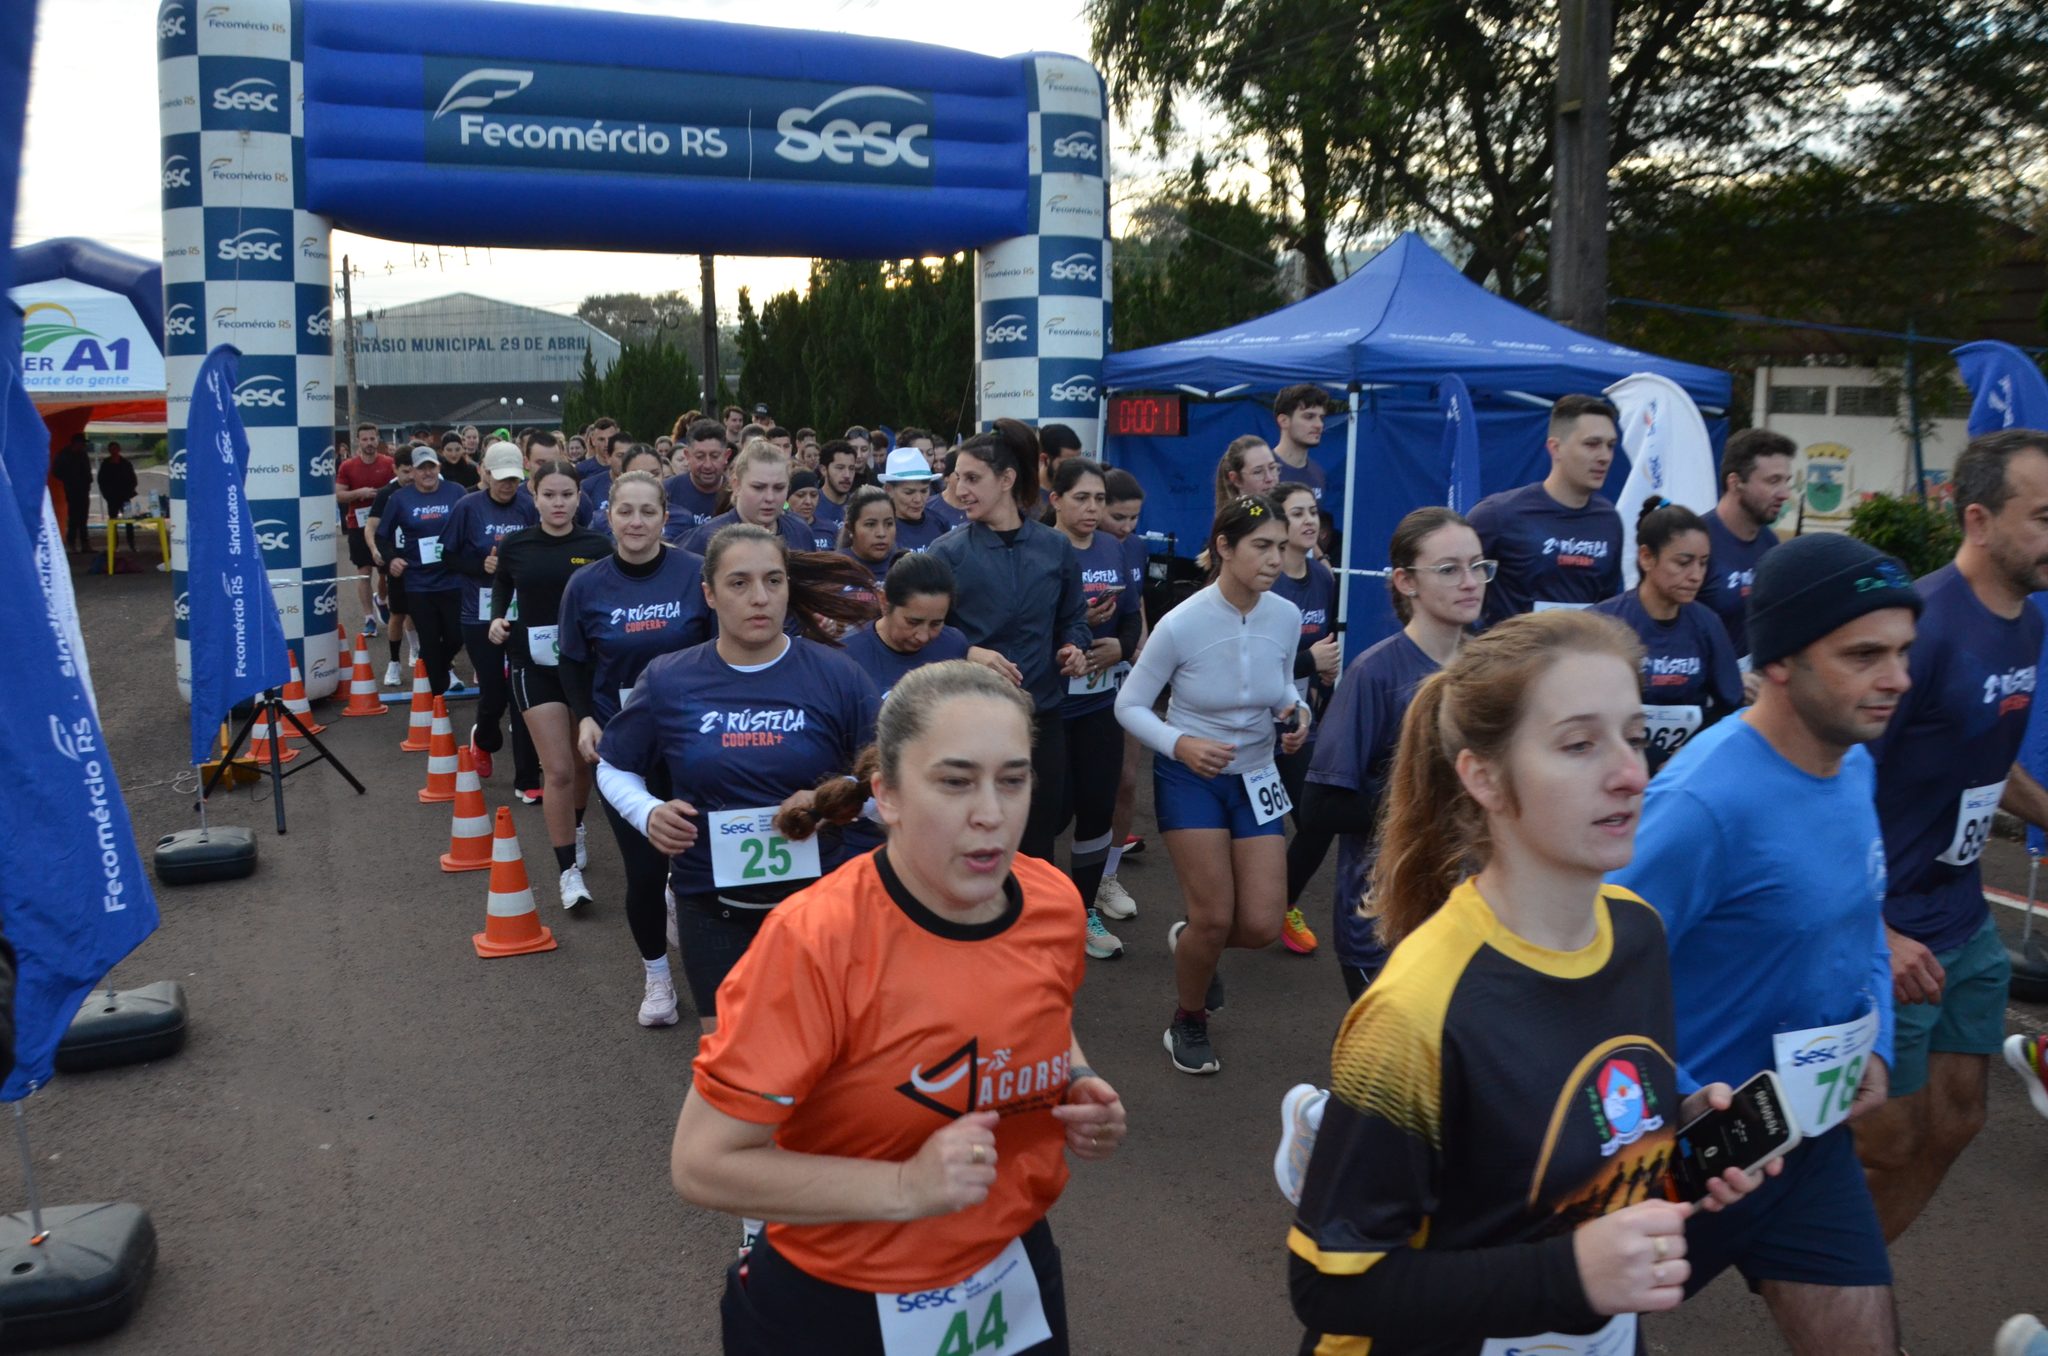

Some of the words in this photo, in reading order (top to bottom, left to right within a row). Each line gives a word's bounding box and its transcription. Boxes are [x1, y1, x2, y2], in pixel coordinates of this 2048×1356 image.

[159, 16, 186, 39] esc
[208, 19, 269, 32] Fecomércio
[272, 23, 286, 34] RS
[213, 87, 278, 112] Sesc
[460, 113, 670, 155] Fecomércio
[681, 126, 728, 158] RS
[775, 105, 930, 168] Sesc
[1053, 138, 1098, 161] Sesc
[162, 167, 191, 189] esc
[213, 170, 272, 182] Fecomércio
[275, 173, 288, 183] RS
[217, 238, 282, 261] Sesc
[1050, 260, 1096, 281] Sesc
[217, 320, 276, 329] Fecomércio
[278, 320, 291, 329] RS
[986, 325, 1028, 344] Sesc
[24, 356, 54, 372] ER
[62, 337, 130, 371] A1
[411, 338, 494, 351] MUNICIPAL
[500, 337, 520, 351] 29
[524, 337, 542, 350] DE
[547, 336, 588, 350] ABRIL
[88, 375, 129, 388] gente
[1050, 383, 1096, 402] Sesc
[247, 465, 280, 475] mércio
[282, 464, 295, 474] RS
[226, 484, 241, 555] Sindicatos
[231, 575, 244, 595] RS
[628, 601, 682, 622] RÚSTICA
[232, 598, 246, 677] Fecomércio
[726, 708, 807, 733] RÚSTICA
[72, 716, 97, 752] RS
[721, 732, 785, 749] COOPERA+
[84, 760, 127, 912] Fecomércio
[720, 822, 755, 835] Sesc
[740, 836, 792, 879] 25
[896, 1287, 957, 1313] Sesc
[935, 1289, 1008, 1356] 44
